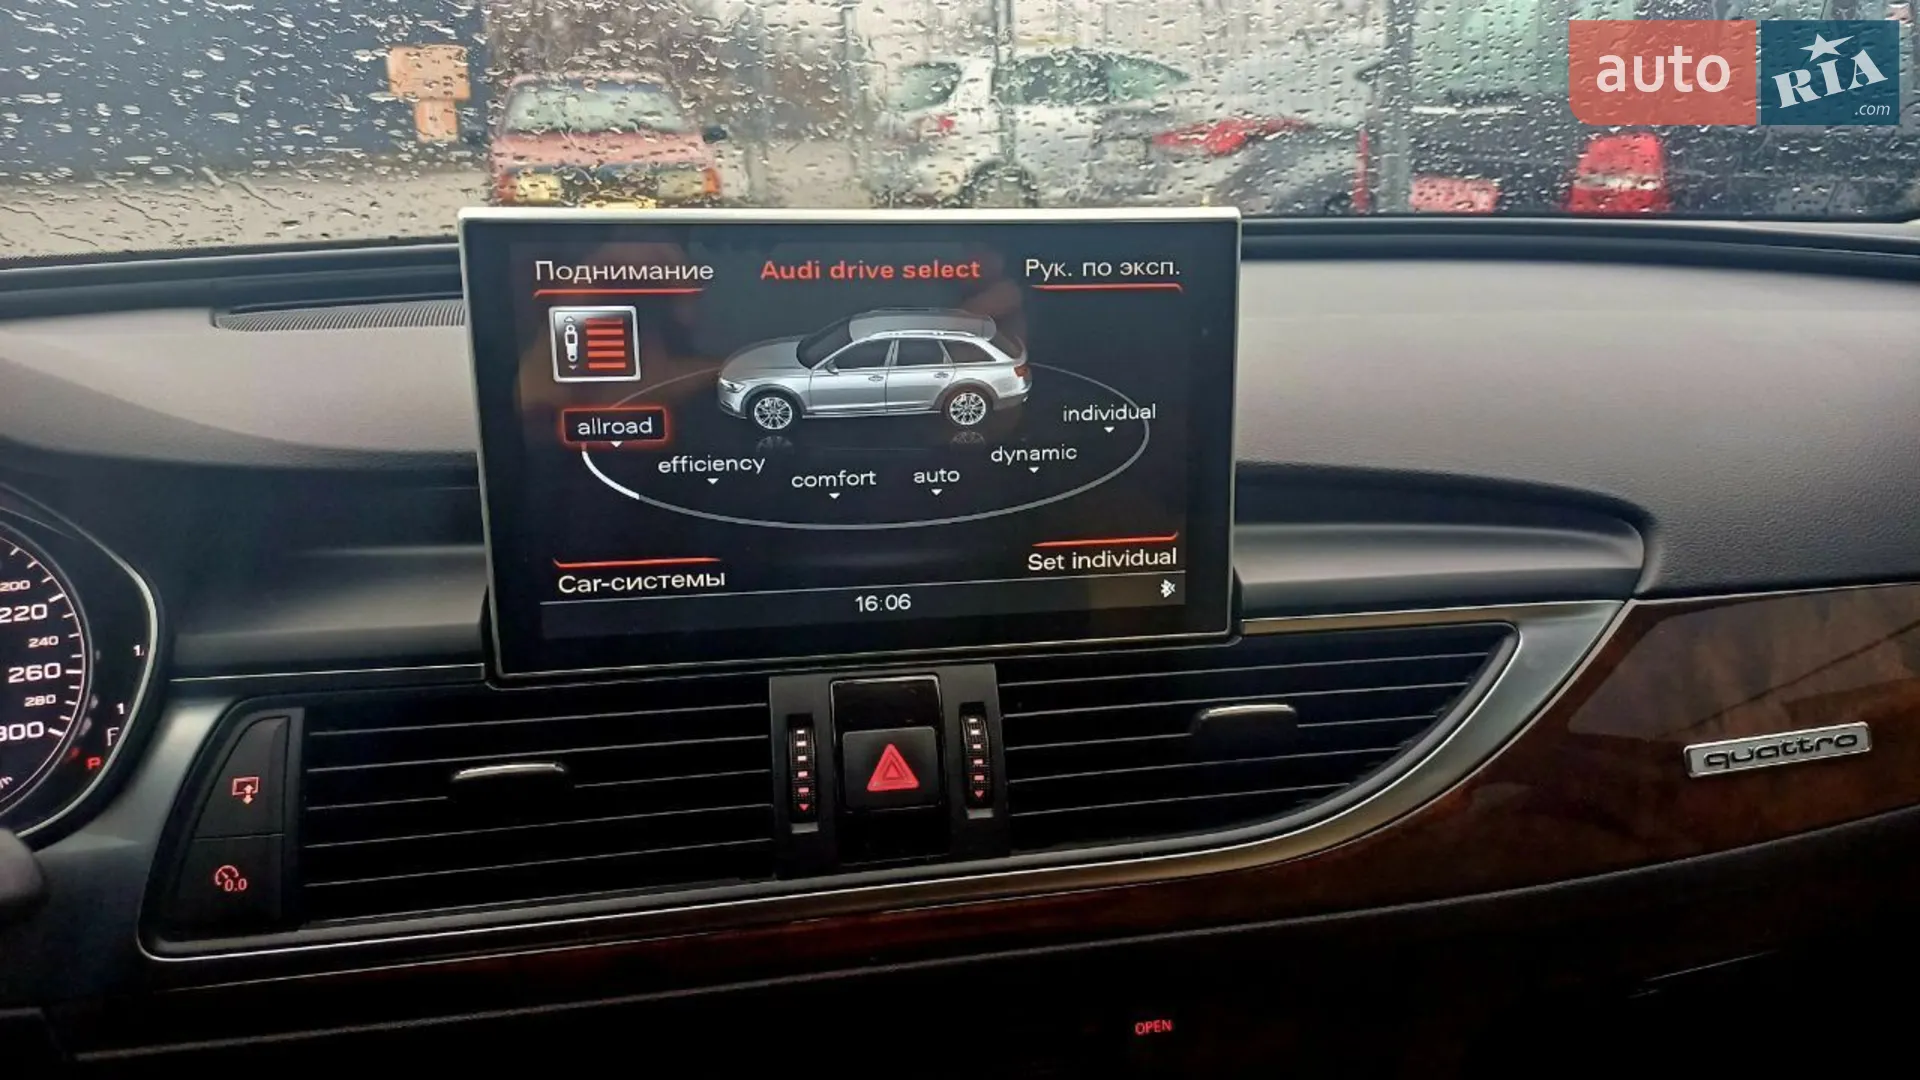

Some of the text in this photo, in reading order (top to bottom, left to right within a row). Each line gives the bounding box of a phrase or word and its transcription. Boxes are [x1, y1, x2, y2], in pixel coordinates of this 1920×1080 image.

[534, 260, 714, 284] Поднимание
[760, 259, 981, 280] Audi drive select
[1025, 258, 1181, 282] Рук. по эксп.
[1063, 403, 1157, 423] individual
[577, 417, 653, 436] allroad
[657, 454, 766, 475] efficiency
[990, 445, 1078, 466] dynamic
[791, 469, 877, 489] comfort
[913, 467, 961, 484] auto
[1027, 547, 1177, 572] Set individual
[558, 571, 726, 594] Car-системы
[854, 592, 912, 613] 16:06
[0, 603, 48, 624] 220
[27, 635, 60, 649] 240
[7, 662, 61, 684] 260
[23, 694, 57, 708] 280
[1703, 734, 1858, 769] quattro
[224, 878, 248, 892] 0.0
[1134, 1019, 1173, 1036] OPEN
